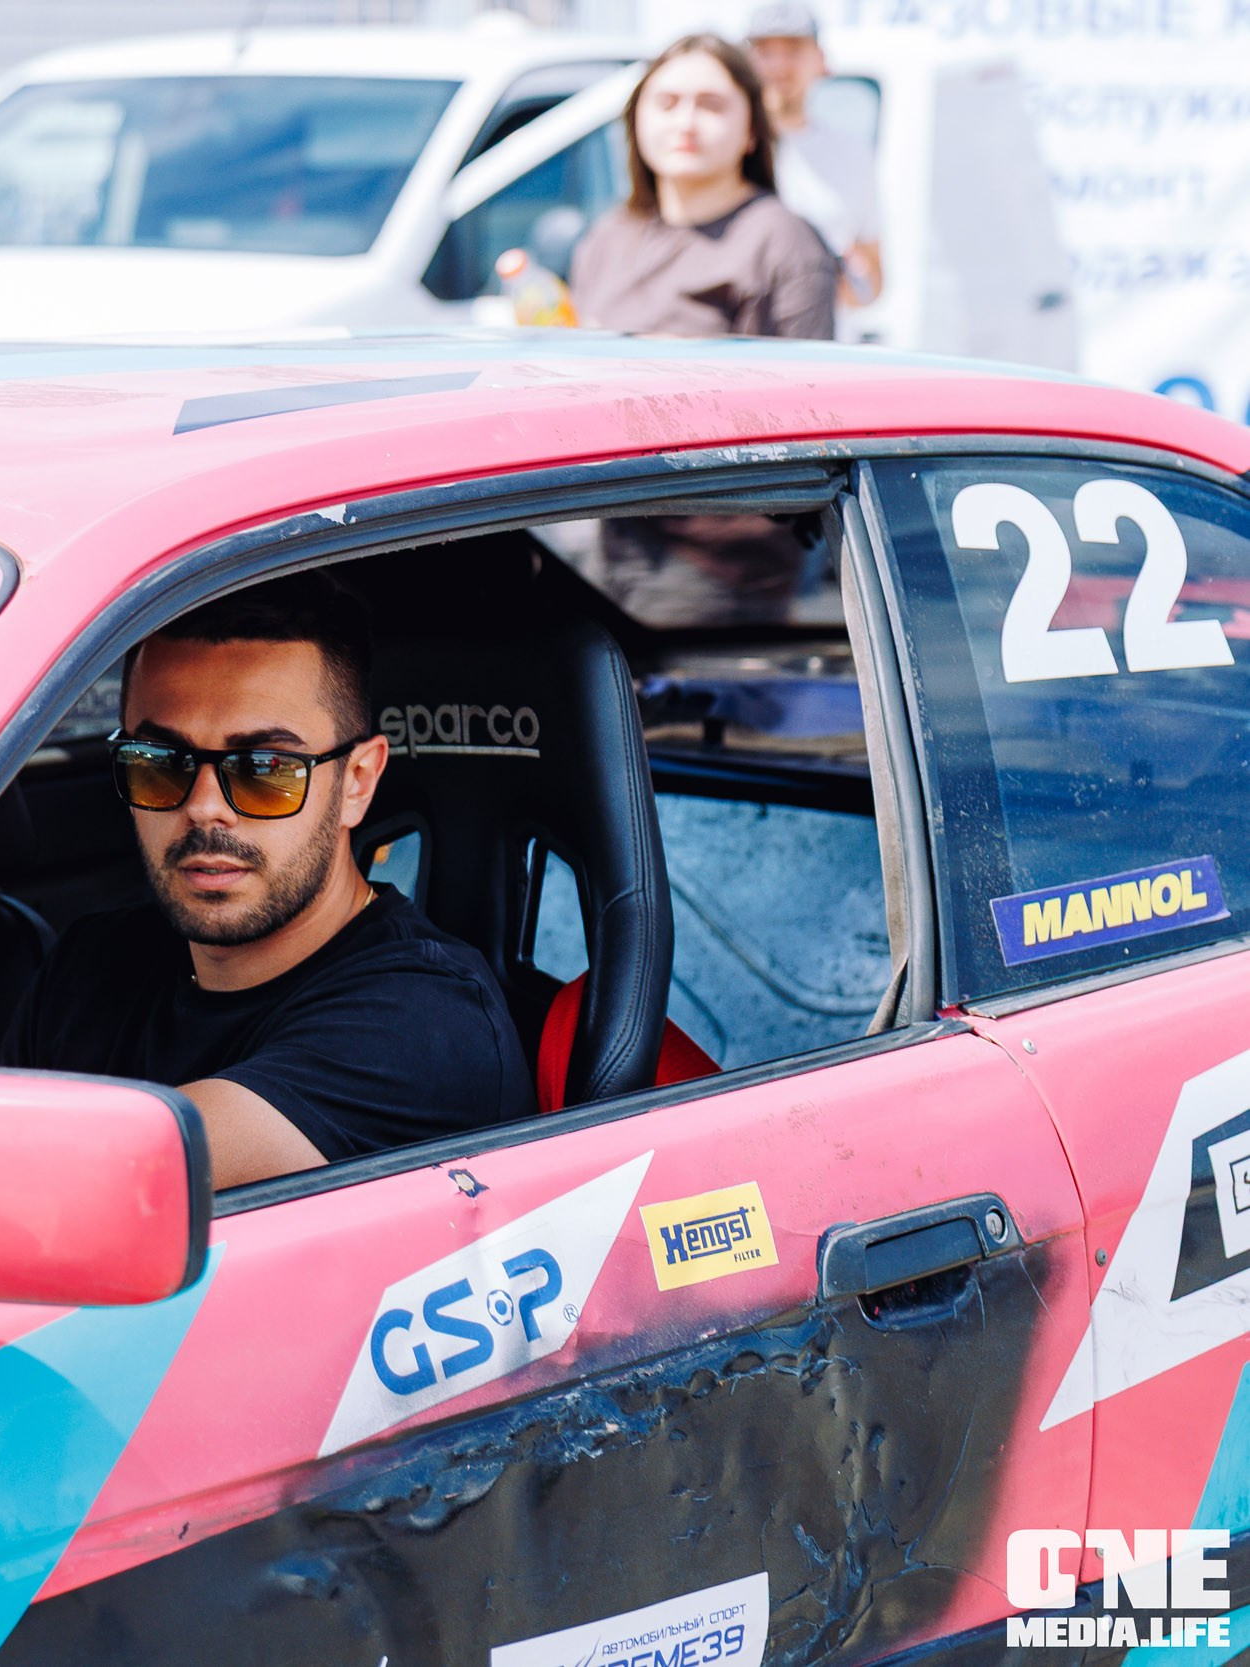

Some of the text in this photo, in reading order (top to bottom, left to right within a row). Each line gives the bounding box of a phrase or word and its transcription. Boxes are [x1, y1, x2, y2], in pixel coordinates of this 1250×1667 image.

[951, 478, 1235, 683] 22
[379, 703, 541, 759] sparco
[1022, 869, 1208, 947] MANNOL
[659, 1206, 752, 1265] Hengst
[733, 1248, 762, 1263] FILTER
[601, 1603, 747, 1657] АВТОМОБИЛЬНЫЙ СПОРТ
